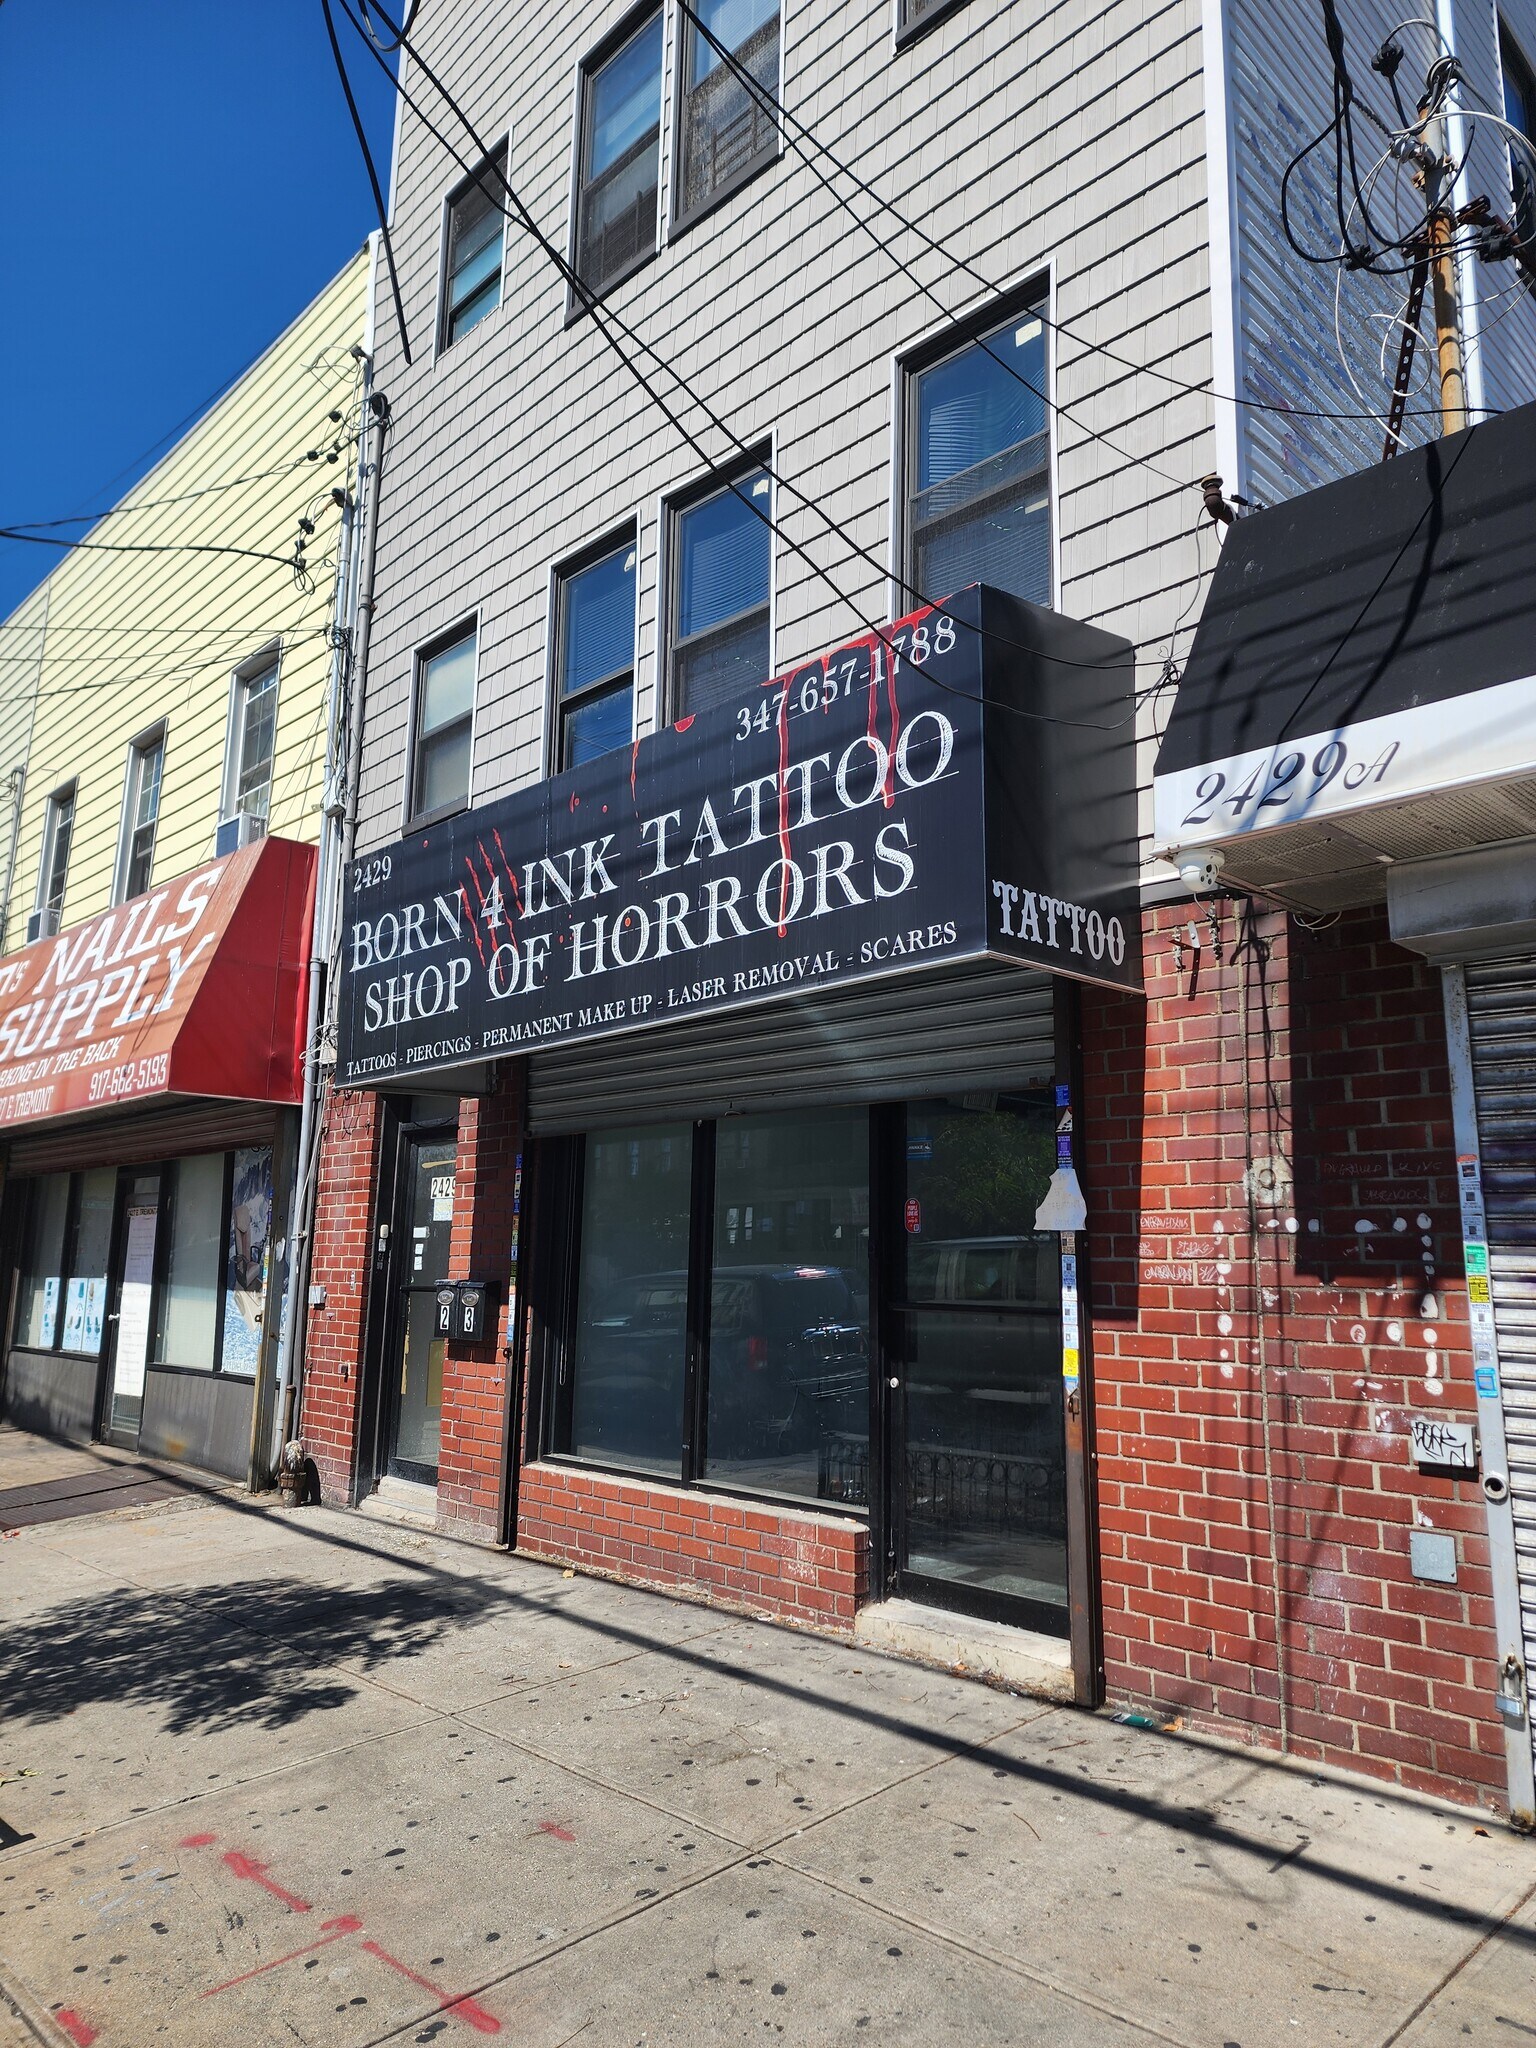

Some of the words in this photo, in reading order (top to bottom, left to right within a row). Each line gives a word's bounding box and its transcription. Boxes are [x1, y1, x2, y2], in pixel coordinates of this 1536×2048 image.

[736, 616, 957, 741] 347-657-1788
[349, 888, 465, 973] BORN
[480, 875, 507, 930] 4
[518, 833, 621, 921] INK
[638, 711, 957, 883] TATTOO
[353, 855, 392, 893] 2429
[32, 866, 224, 996] NAILS
[364, 957, 473, 1034] SHOP
[486, 933, 553, 1002] OF
[565, 822, 918, 983] HORRORS
[992, 880, 1127, 966] TATTOO
[0, 931, 215, 1061] SUPPLY
[346, 1052, 397, 1076] TATTOOS
[406, 1036, 471, 1064] PIERCINGS
[482, 1012, 573, 1048] PERMANENT
[577, 1000, 625, 1028] MAKE
[631, 994, 653, 1016] UP
[667, 977, 727, 1008] LASER
[733, 950, 839, 993] REMOVAL
[860, 921, 957, 964] SCARES
[32, 1056, 54, 1080] IN
[52, 1046, 83, 1075] THE
[80, 1035, 125, 1067] BACK
[89, 1053, 169, 1101] 917-662-5193
[5, 1095, 15, 1120] E
[14, 1086, 55, 1118] TREMONT
[432, 1178, 456, 1198] 2429
[441, 1307, 448, 1329] 2
[465, 1308, 473, 1331] 3
